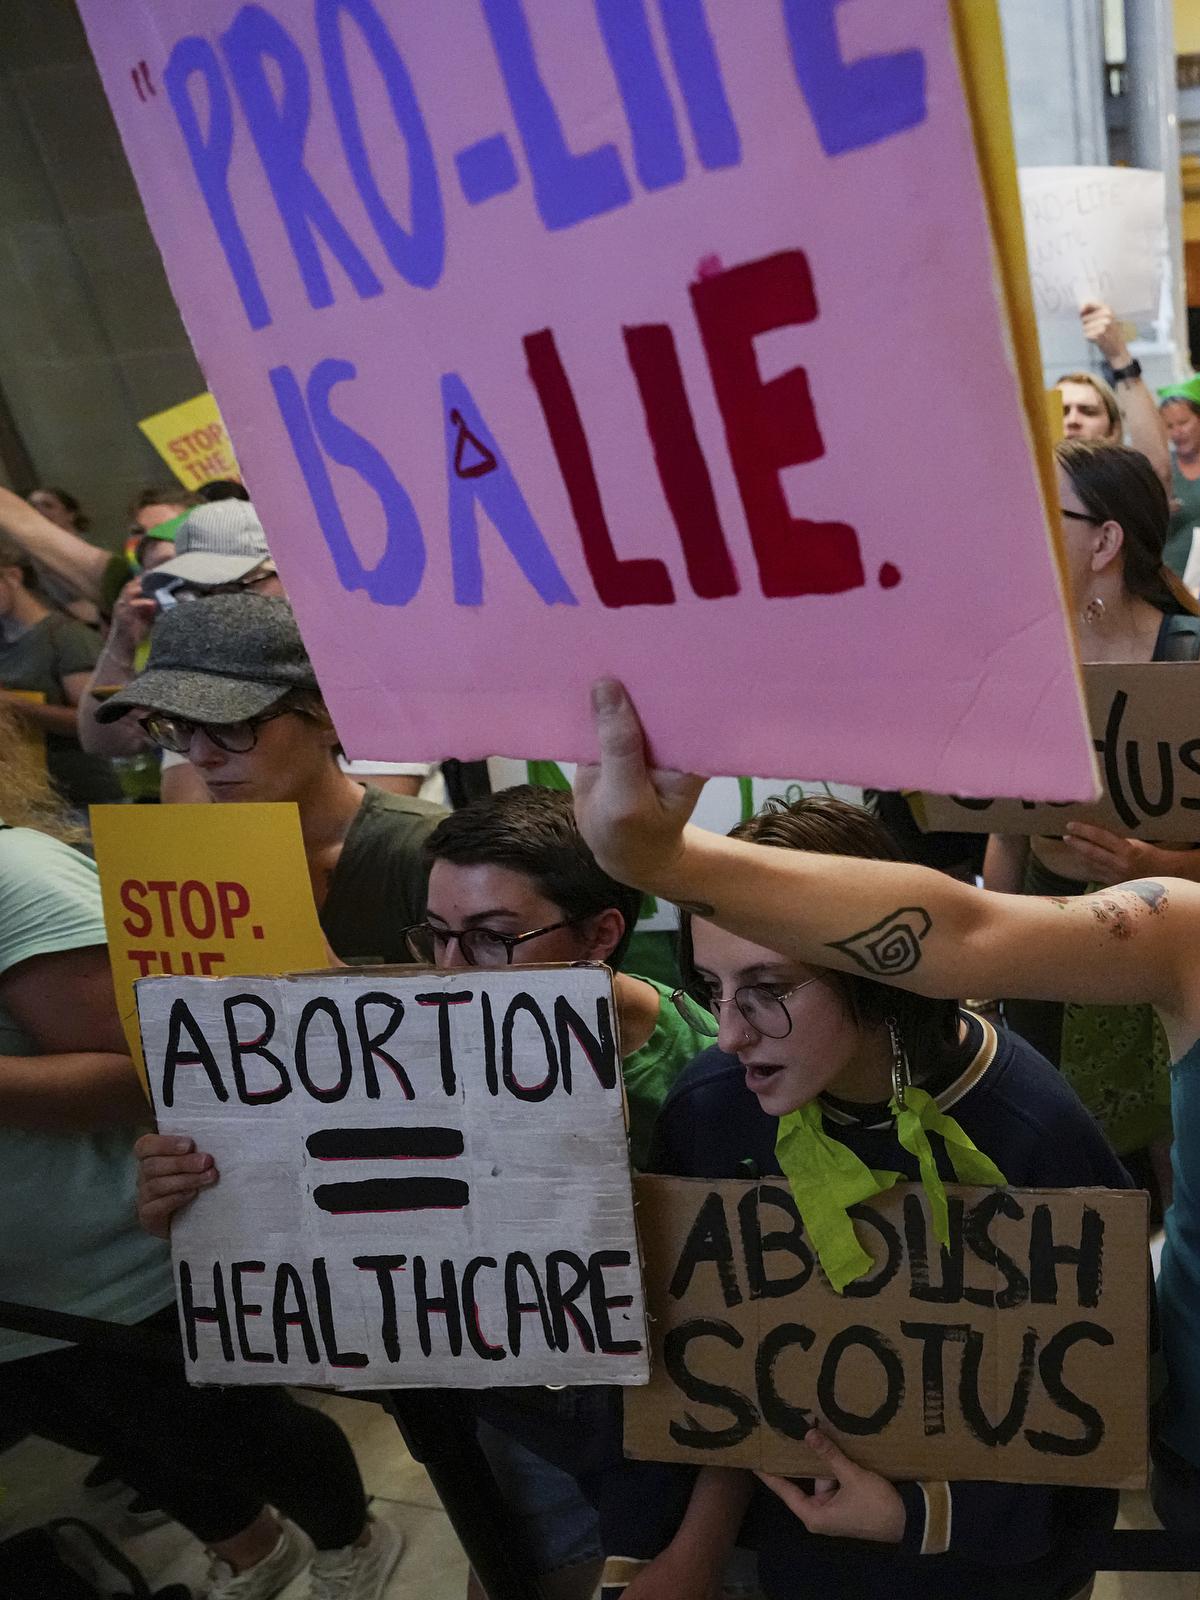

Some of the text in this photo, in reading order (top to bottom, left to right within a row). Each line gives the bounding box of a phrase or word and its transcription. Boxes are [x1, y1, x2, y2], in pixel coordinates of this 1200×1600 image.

[268, 247, 902, 609] IS A LIE.
[120, 879, 265, 940] STOP.
[162, 991, 617, 1107] ABORTION
[668, 1185, 1105, 1310] ABOLISH
[179, 1250, 643, 1369] HEALTHCARE
[663, 1317, 1115, 1456] SCOTUS
